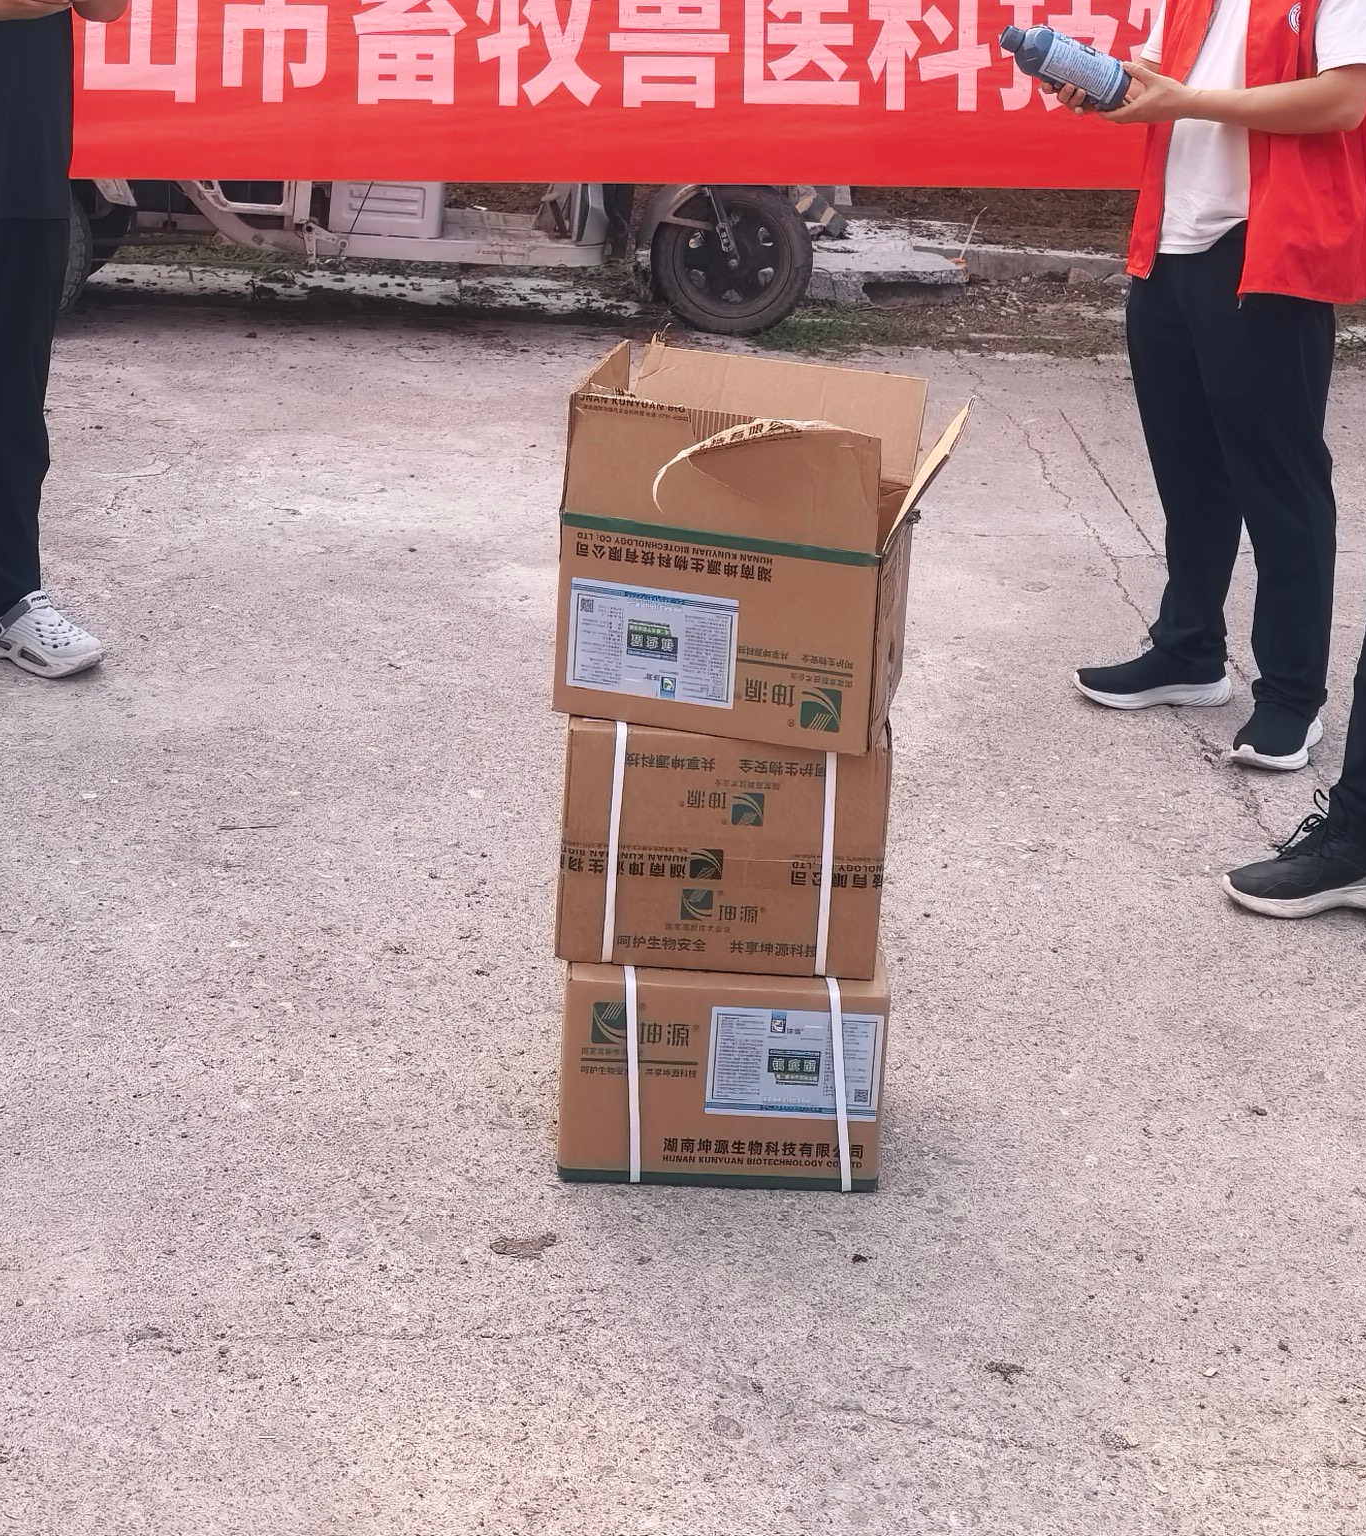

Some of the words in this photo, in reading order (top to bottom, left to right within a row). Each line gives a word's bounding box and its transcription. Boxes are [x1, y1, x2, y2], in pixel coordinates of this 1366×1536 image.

[577, 531, 593, 540] LTD
[615, 537, 690, 553] BIOTECHNOLOGY
[692, 546, 736, 561] KUNYUAN
[576, 541, 773, 583] 湖南坤源生物科技有限公司
[740, 553, 773, 565] HUNAN
[745, 677, 795, 707] 坤源
[625, 752, 715, 771] 共享坤源科技
[739, 759, 826, 777] 呵护生物安全
[687, 789, 727, 809] 坤源
[589, 849, 645, 860] KUNAN
[648, 854, 688, 863] HUNAN
[718, 904, 758, 924] 坤源
[616, 935, 706, 952] 呵护生物安全
[730, 940, 816, 958] 共享坤源科技
[639, 1022, 690, 1048] 坤源
[580, 1065, 628, 1076] 呵护生物安
[662, 1155, 695, 1164] HUNAN
[698, 1156, 744, 1166] KUNYUAN
[746, 1157, 823, 1168] BIOTECHNOLOGY
[850, 1161, 863, 1170] TD
